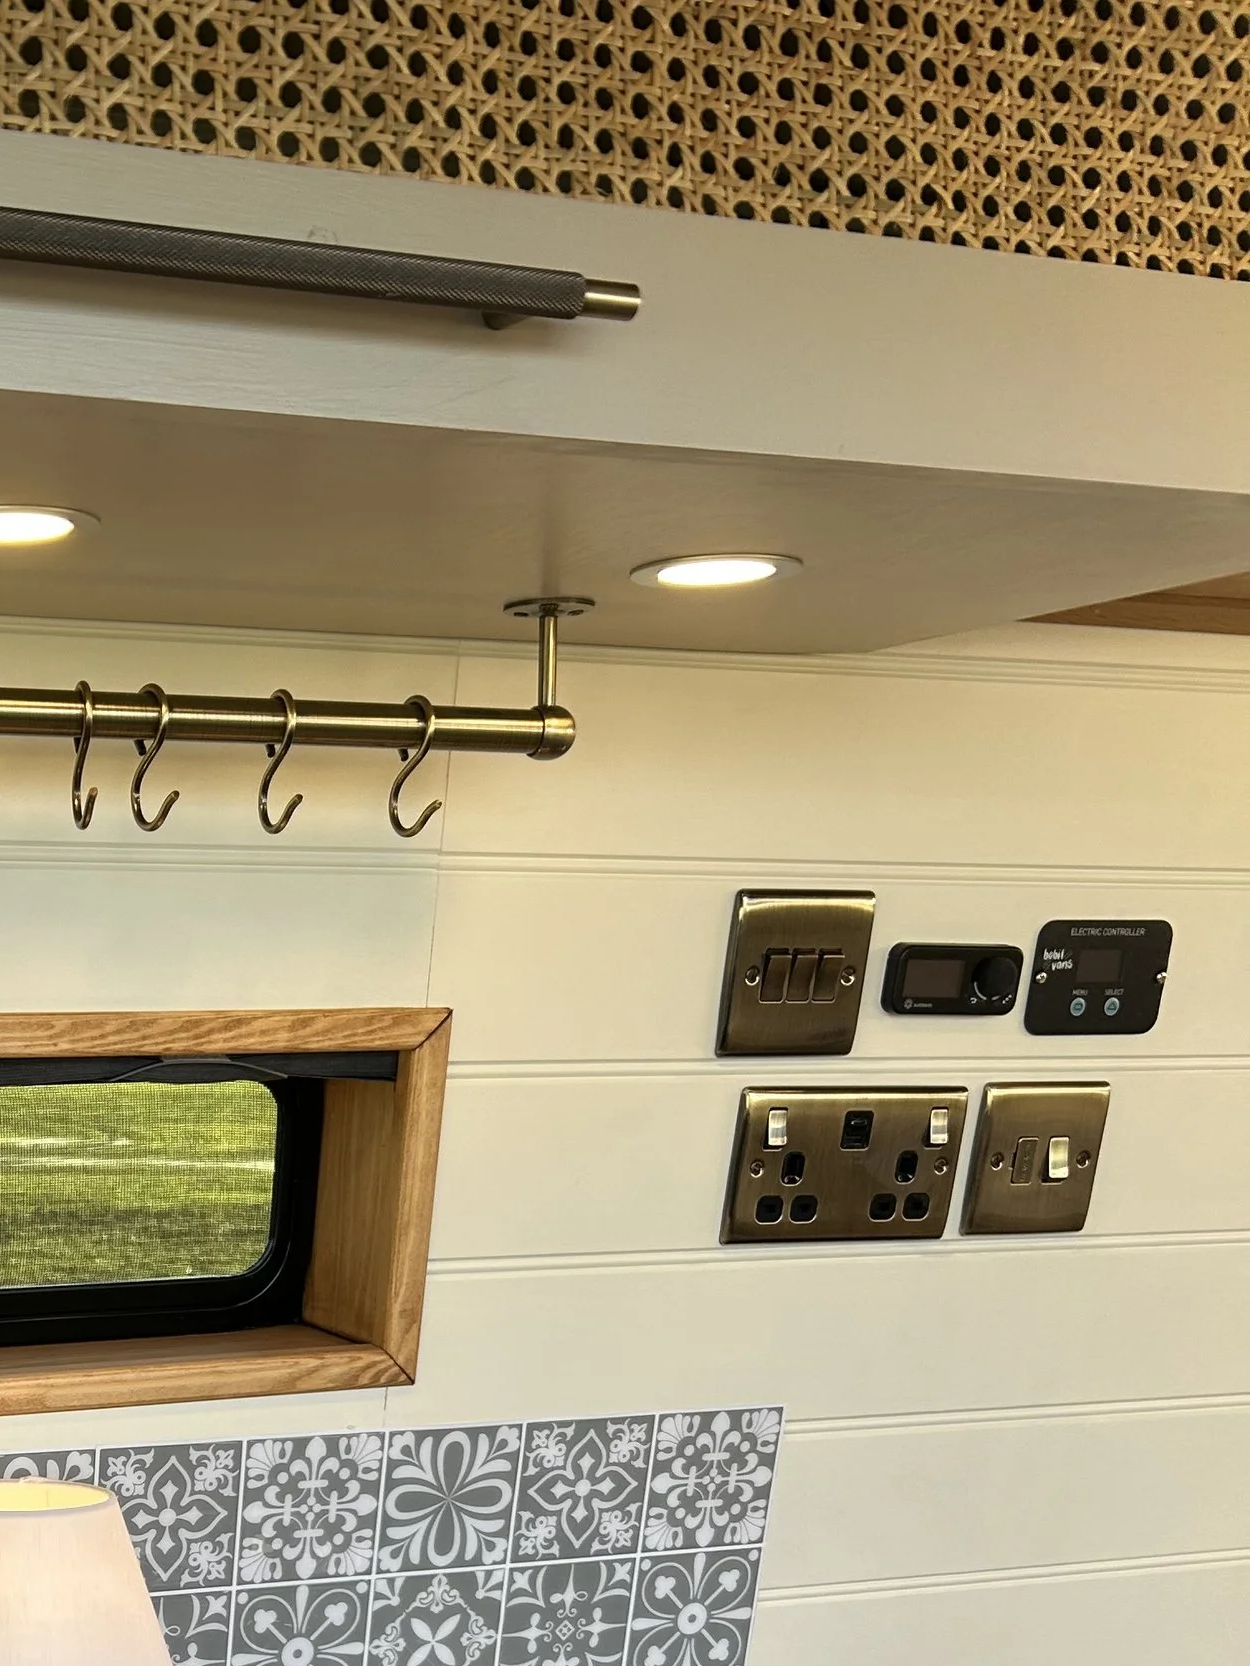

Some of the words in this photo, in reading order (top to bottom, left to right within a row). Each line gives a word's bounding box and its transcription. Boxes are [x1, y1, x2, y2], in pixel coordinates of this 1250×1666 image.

[1070, 927, 1102, 936] ELECTRIC
[1103, 927, 1146, 936] CONTROLLER
[1051, 959, 1073, 971] vans
[1104, 988, 1125, 996] SELECT
